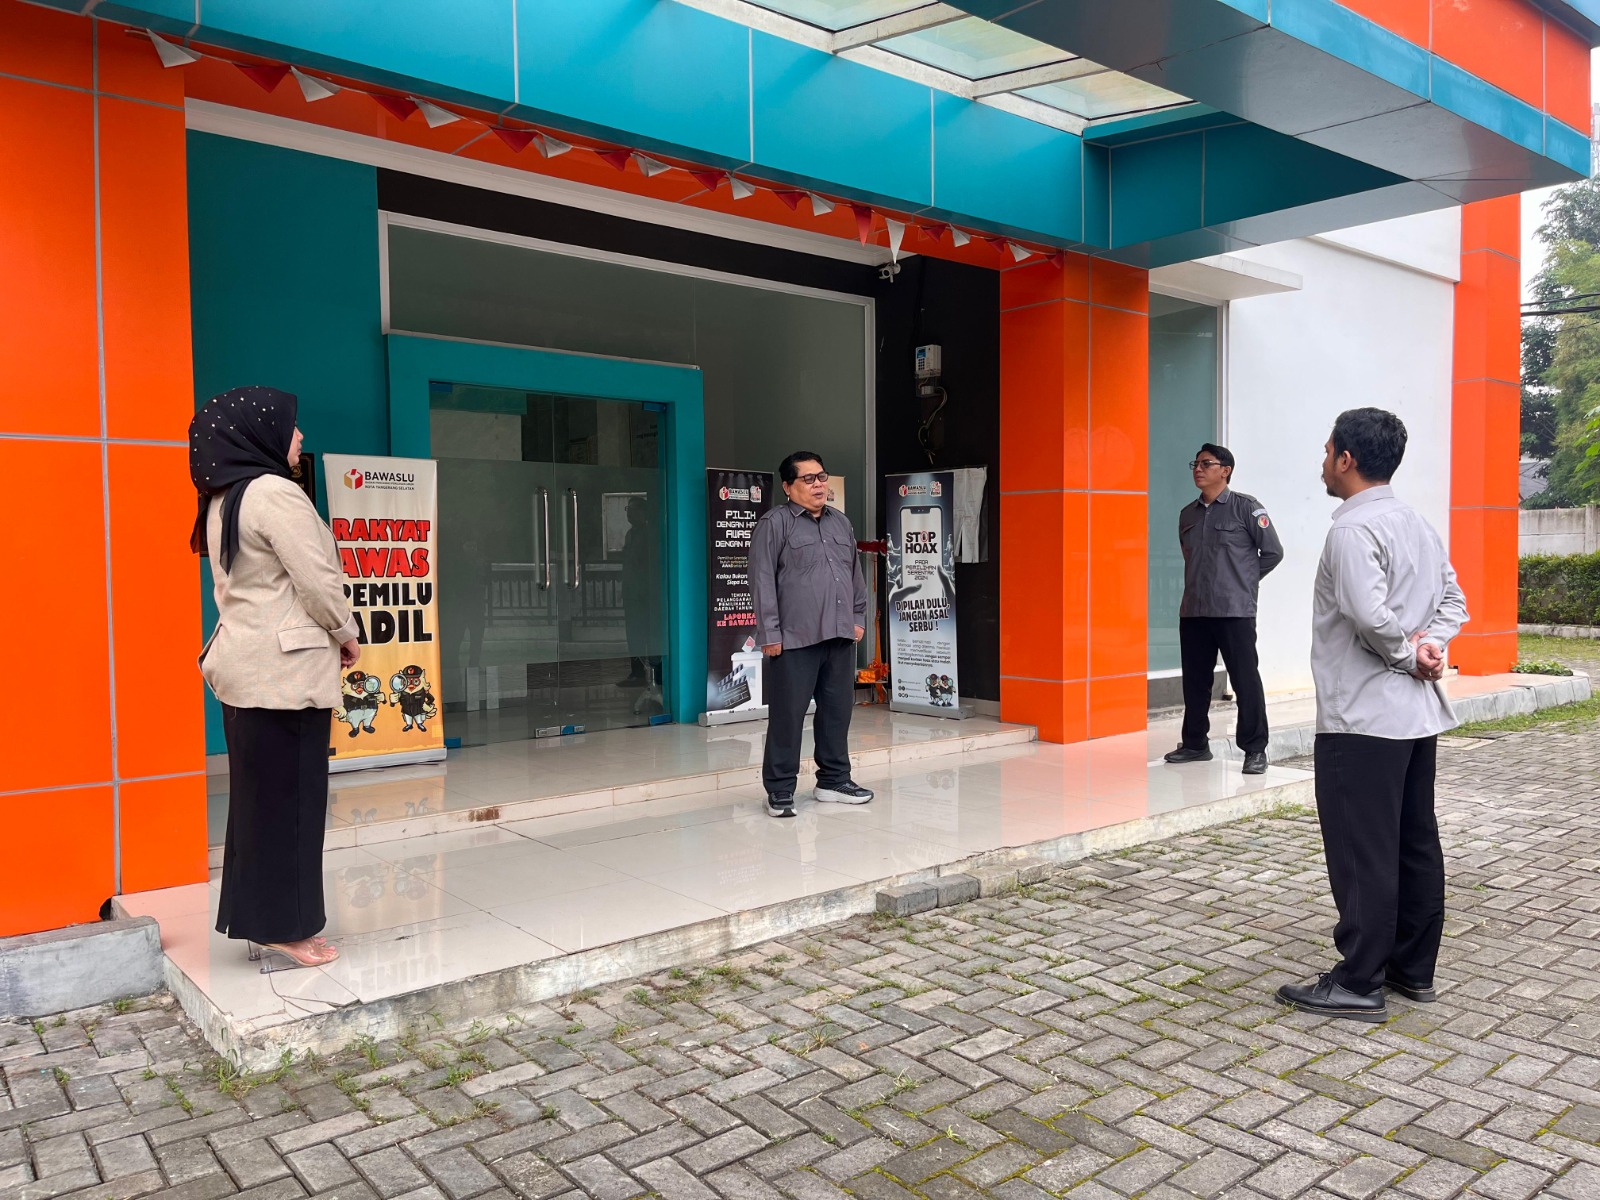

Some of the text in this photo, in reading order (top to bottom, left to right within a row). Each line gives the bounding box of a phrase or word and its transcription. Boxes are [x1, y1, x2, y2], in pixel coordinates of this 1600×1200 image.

[365, 471, 415, 483] BAWASLU
[726, 510, 756, 520] PILIH
[332, 518, 430, 542] RAKYAT
[906, 531, 936, 542] STOP
[906, 543, 938, 554] HOAX
[339, 547, 429, 578] AWAS
[896, 598, 950, 611] DIPILAH DULU,
[898, 609, 948, 622] JANGAN ASAL
[909, 621, 934, 632] SERBU
